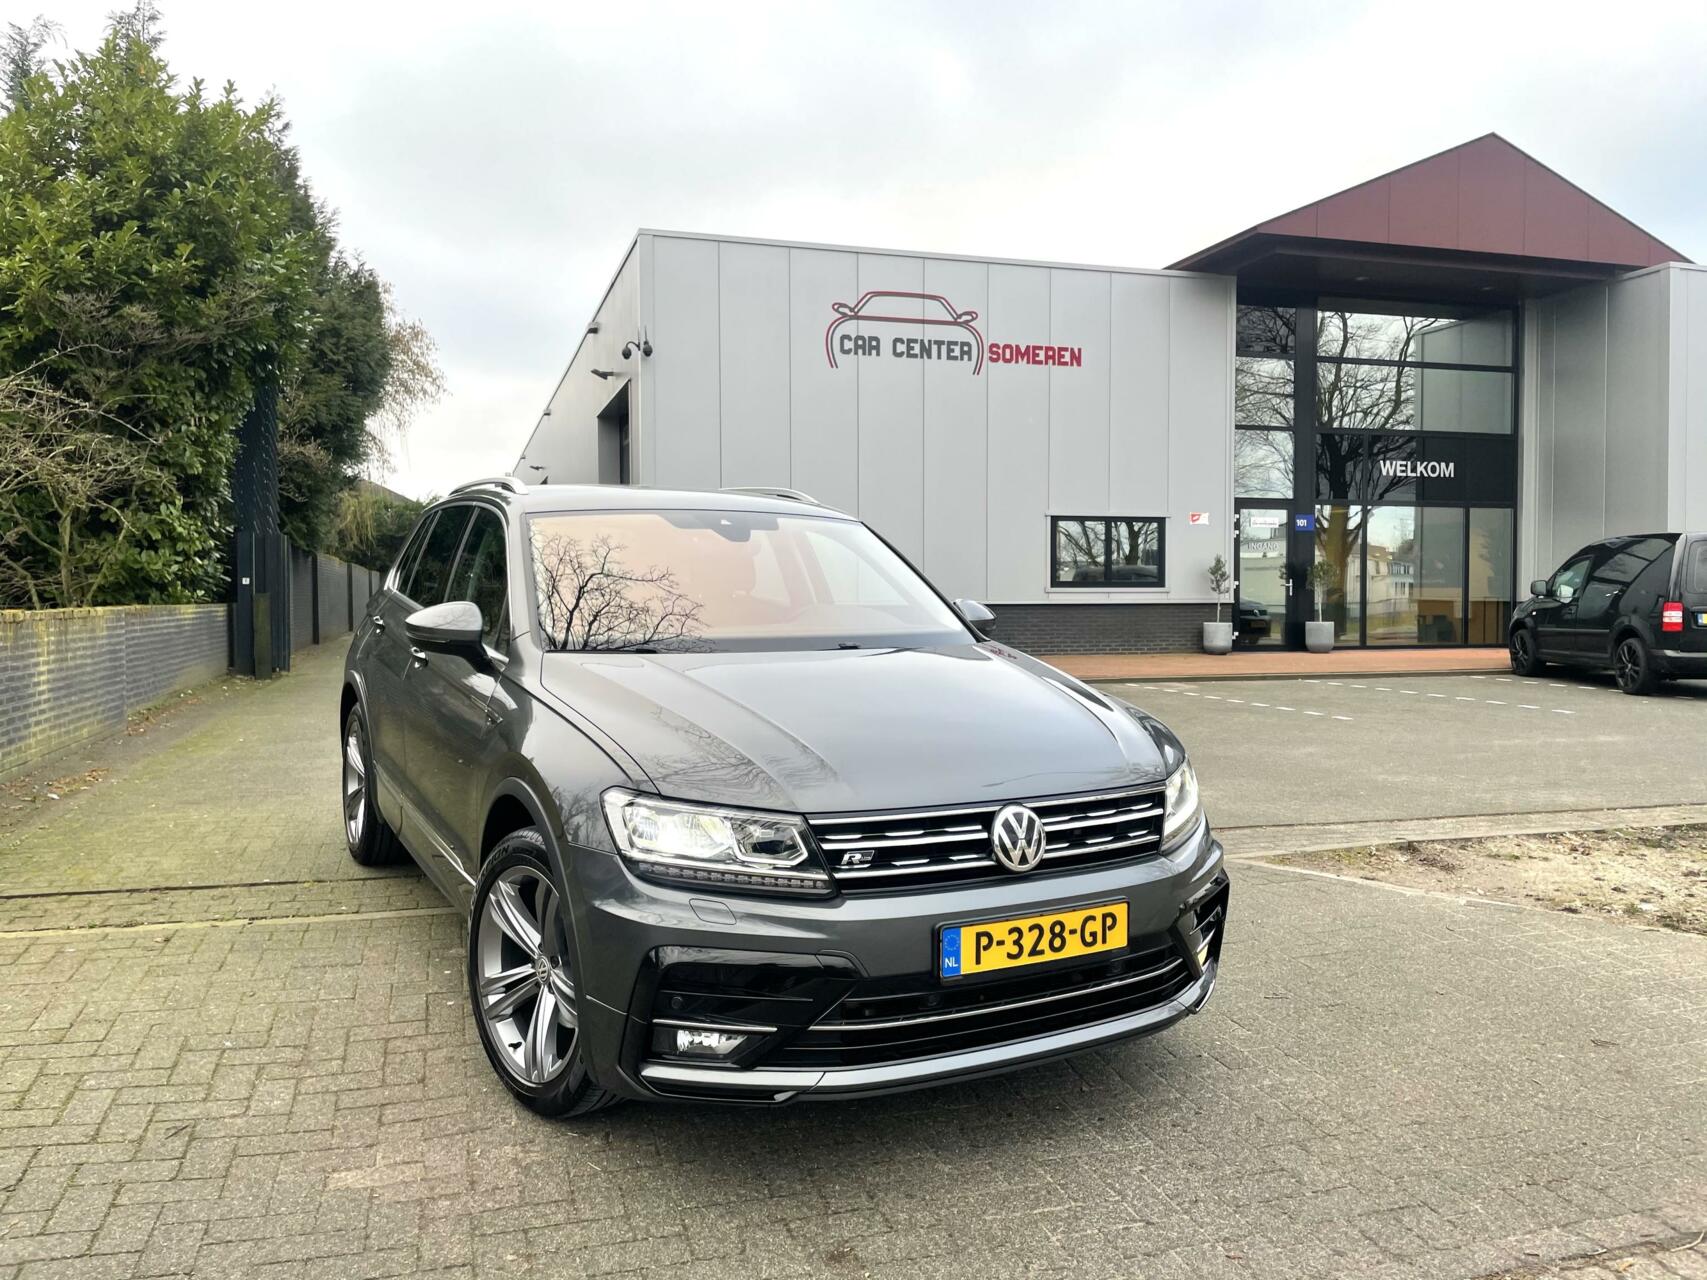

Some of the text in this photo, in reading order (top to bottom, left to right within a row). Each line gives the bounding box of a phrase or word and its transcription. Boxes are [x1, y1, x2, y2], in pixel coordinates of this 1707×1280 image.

[839, 334, 1082, 368] CAR CENTER SOMEREN
[1379, 459, 1455, 478] WELKOM
[1295, 519, 1307, 527] 101
[975, 911, 1118, 966] P-328-GP
[944, 957, 959, 969] NL
